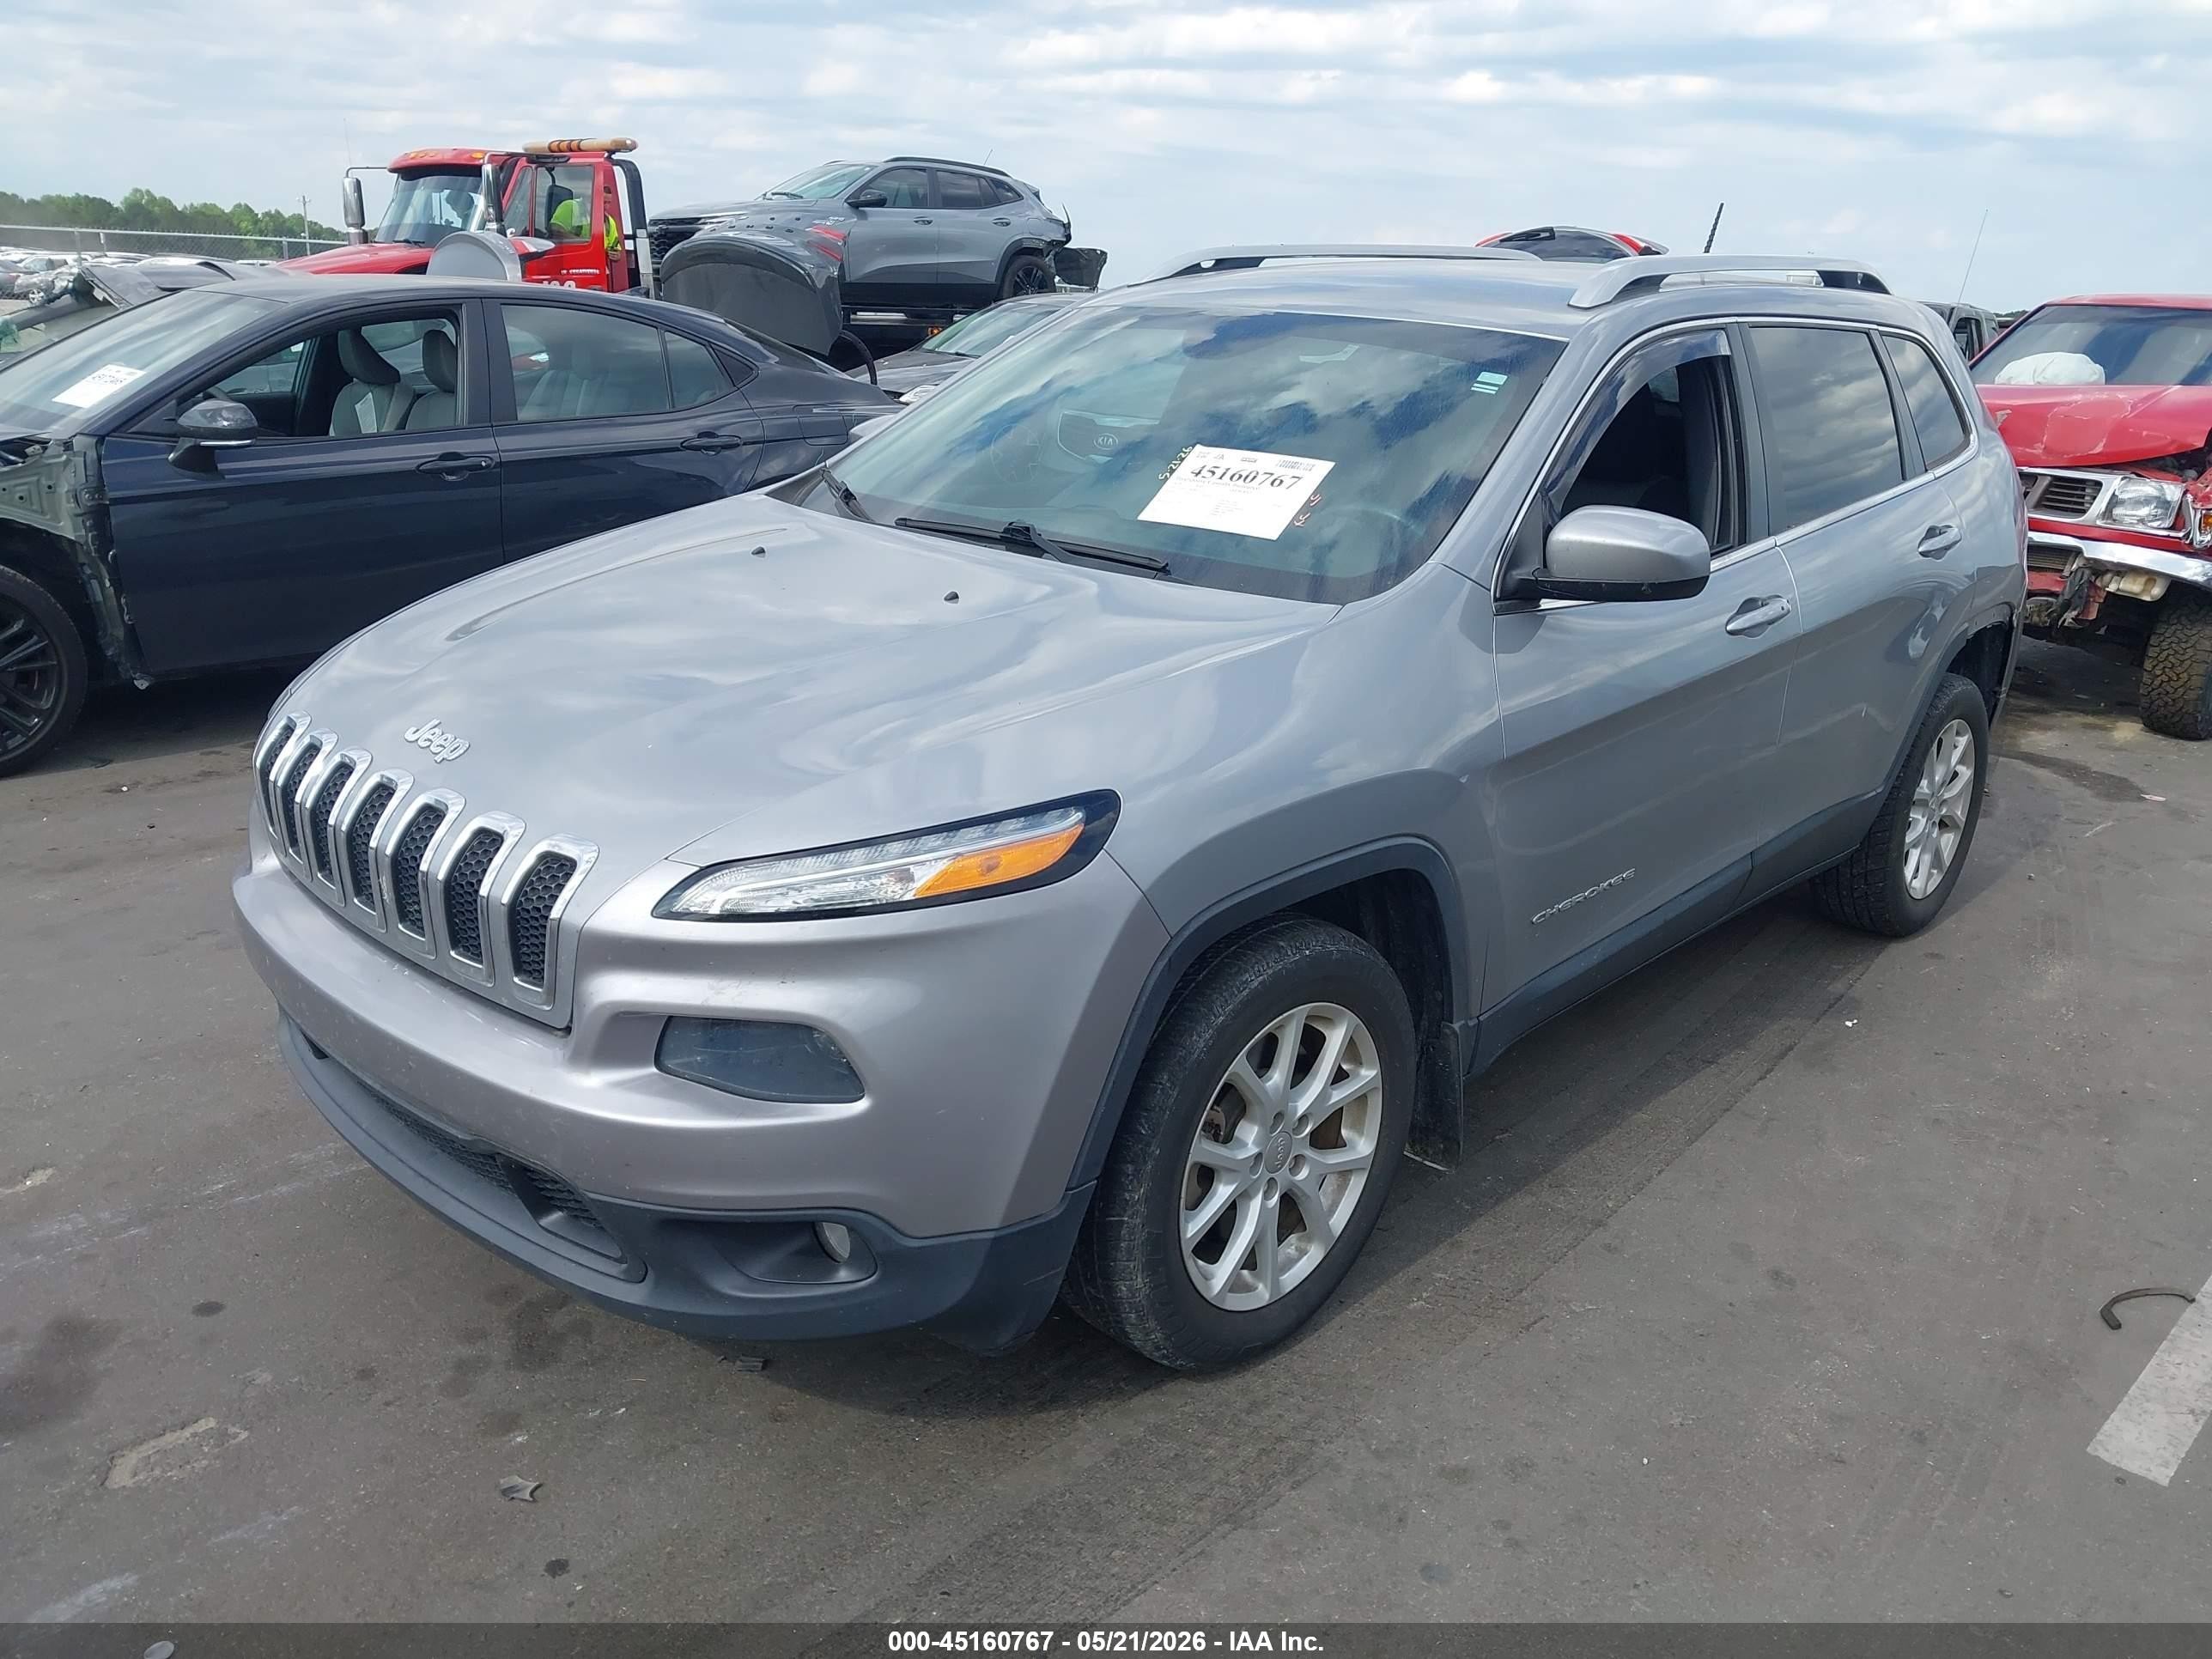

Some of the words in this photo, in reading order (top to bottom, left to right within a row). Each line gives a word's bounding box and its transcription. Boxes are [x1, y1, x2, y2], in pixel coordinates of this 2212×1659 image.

[1191, 465, 1304, 489] 45160767
[404, 718, 471, 764] Jeep
[1532, 868, 1636, 924] CHEROKEE
